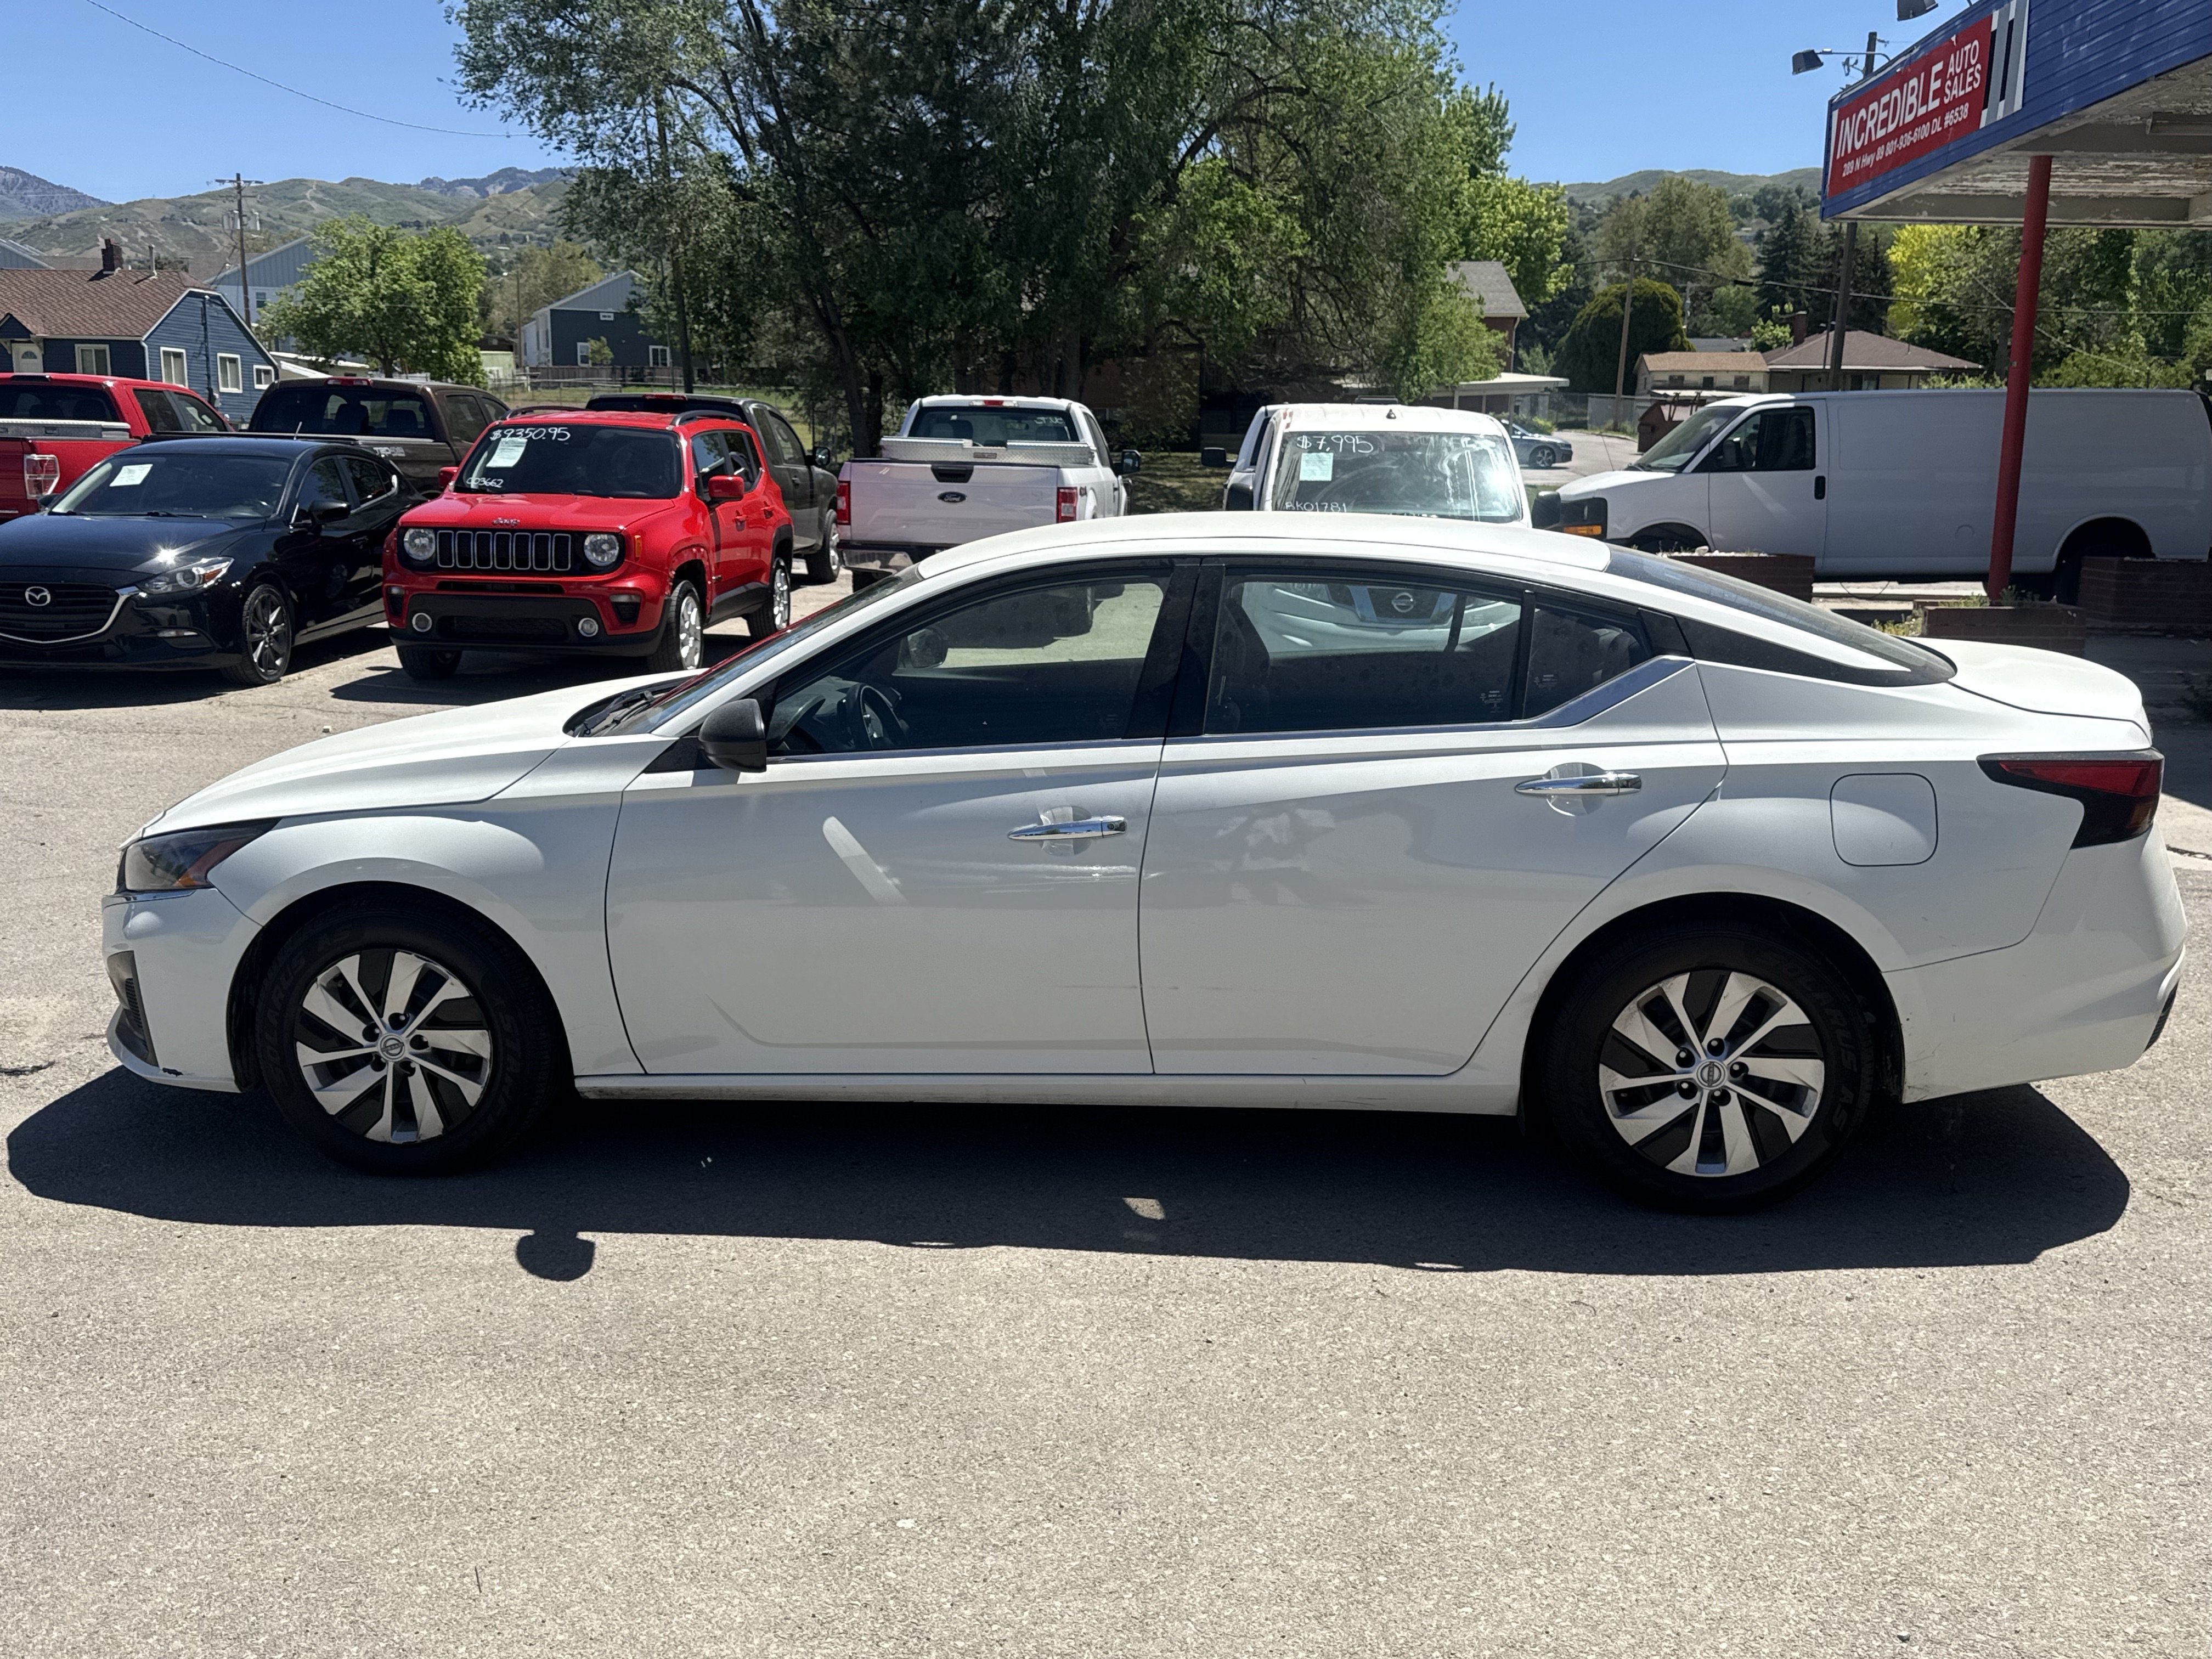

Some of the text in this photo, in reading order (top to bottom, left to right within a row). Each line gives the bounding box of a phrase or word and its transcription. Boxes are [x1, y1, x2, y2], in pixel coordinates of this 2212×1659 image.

[1946, 39, 1979, 80] AUTO
[1943, 63, 1982, 104] SALES
[1836, 60, 1944, 160] INCREDIBLE
[1854, 156, 1861, 172] N
[1861, 153, 1876, 168] Hwy
[1876, 144, 1884, 161] 89
[1885, 122, 1930, 157] 801-936-6100
[1931, 116, 1942, 135] DL
[1944, 102, 1969, 129] #6538
[489, 427, 571, 441] $9350.95
[1296, 435, 1374, 453] $7,995
